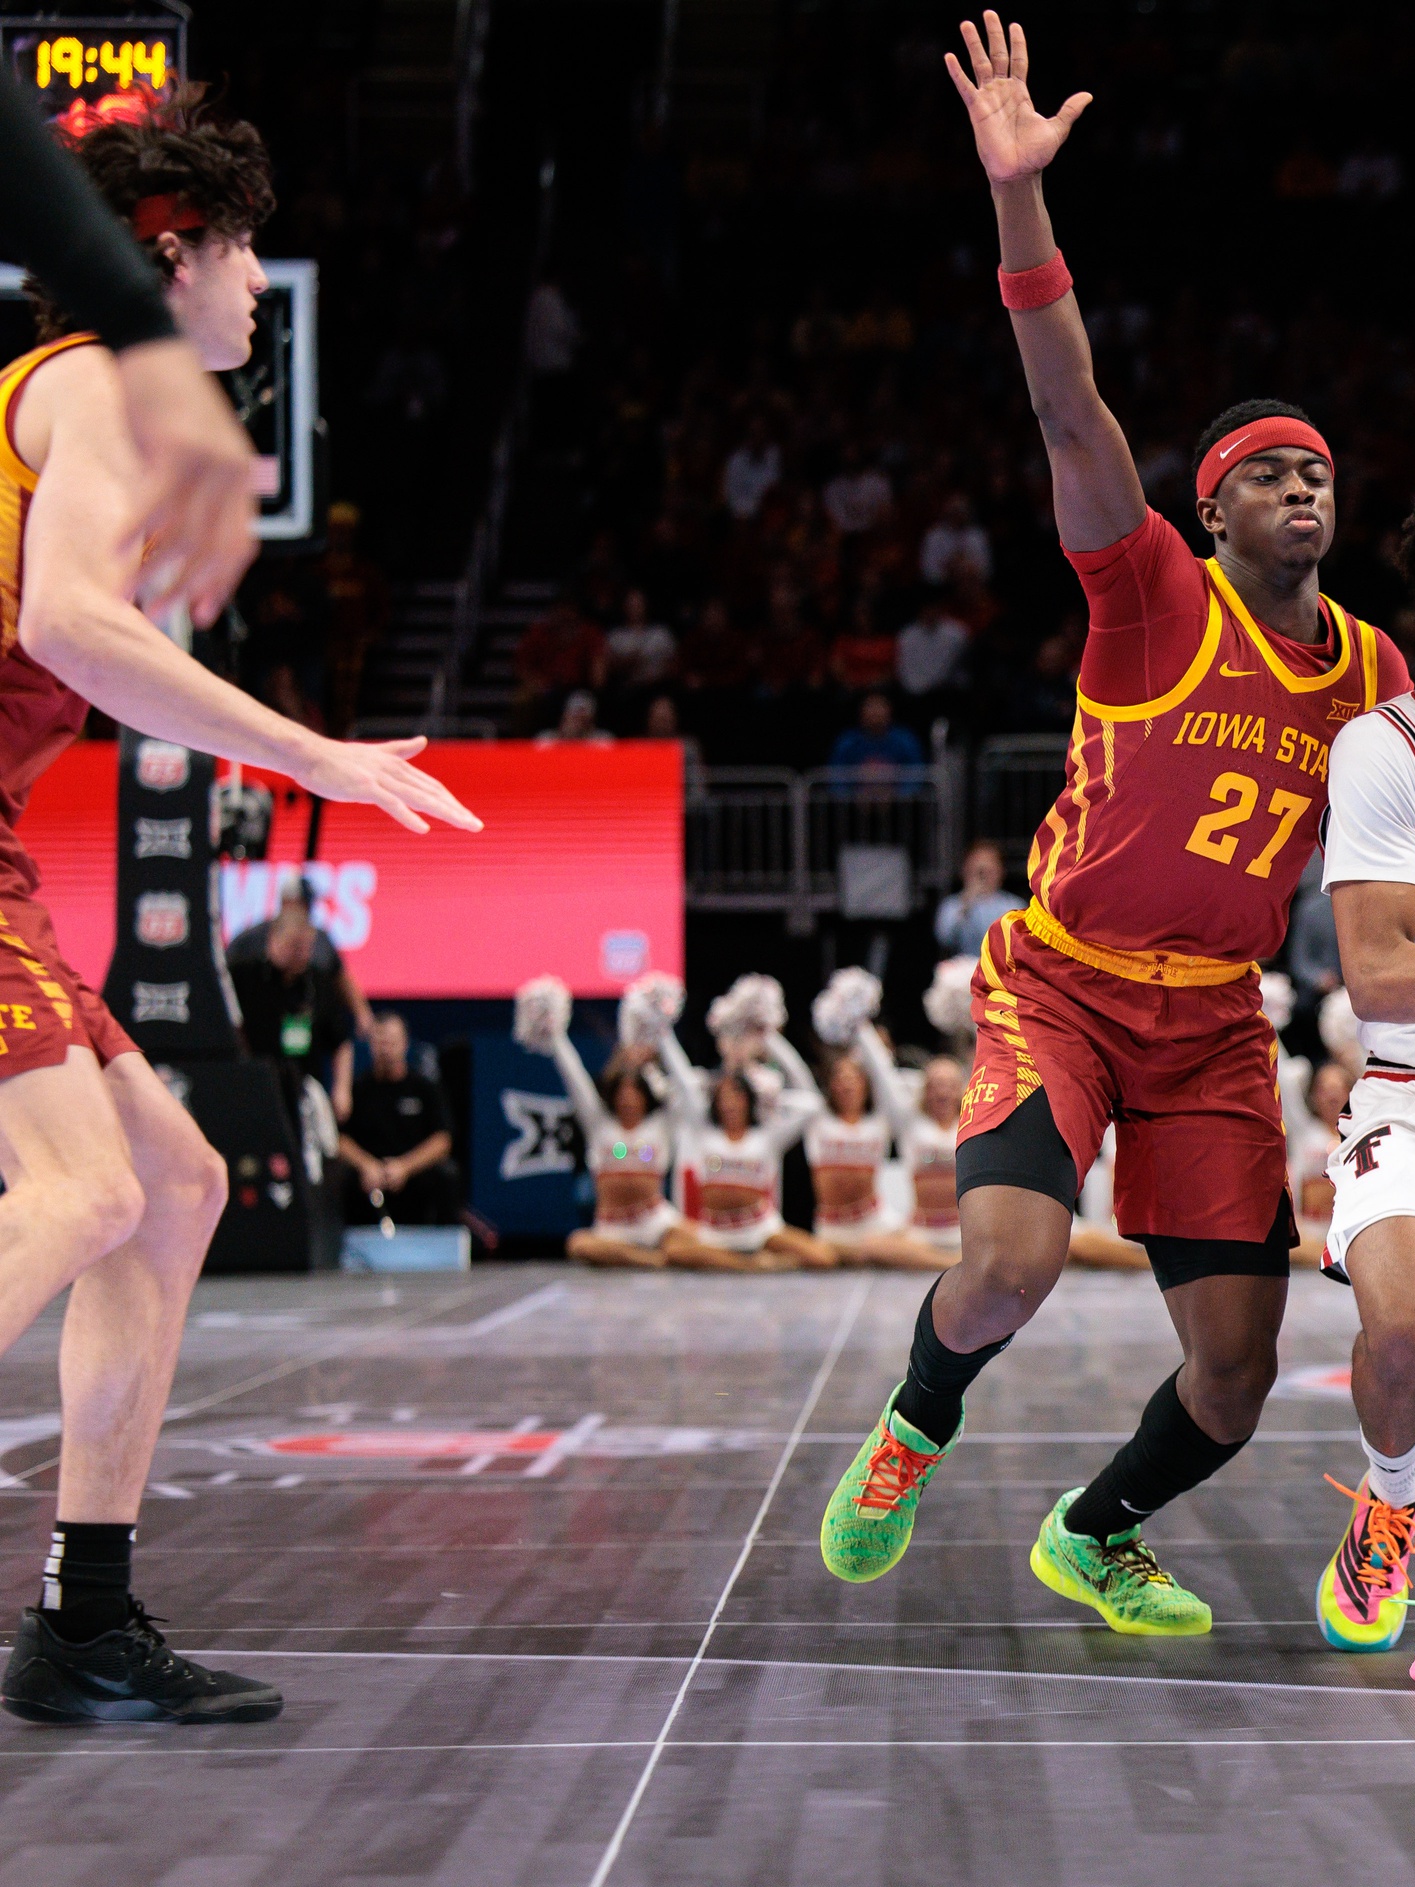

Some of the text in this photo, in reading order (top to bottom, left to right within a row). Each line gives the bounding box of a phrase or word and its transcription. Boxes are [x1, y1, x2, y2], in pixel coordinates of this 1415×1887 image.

[37, 36, 166, 89] 19:44
[1172, 711, 1330, 783] IOWA STA
[1185, 771, 1312, 879] 27
